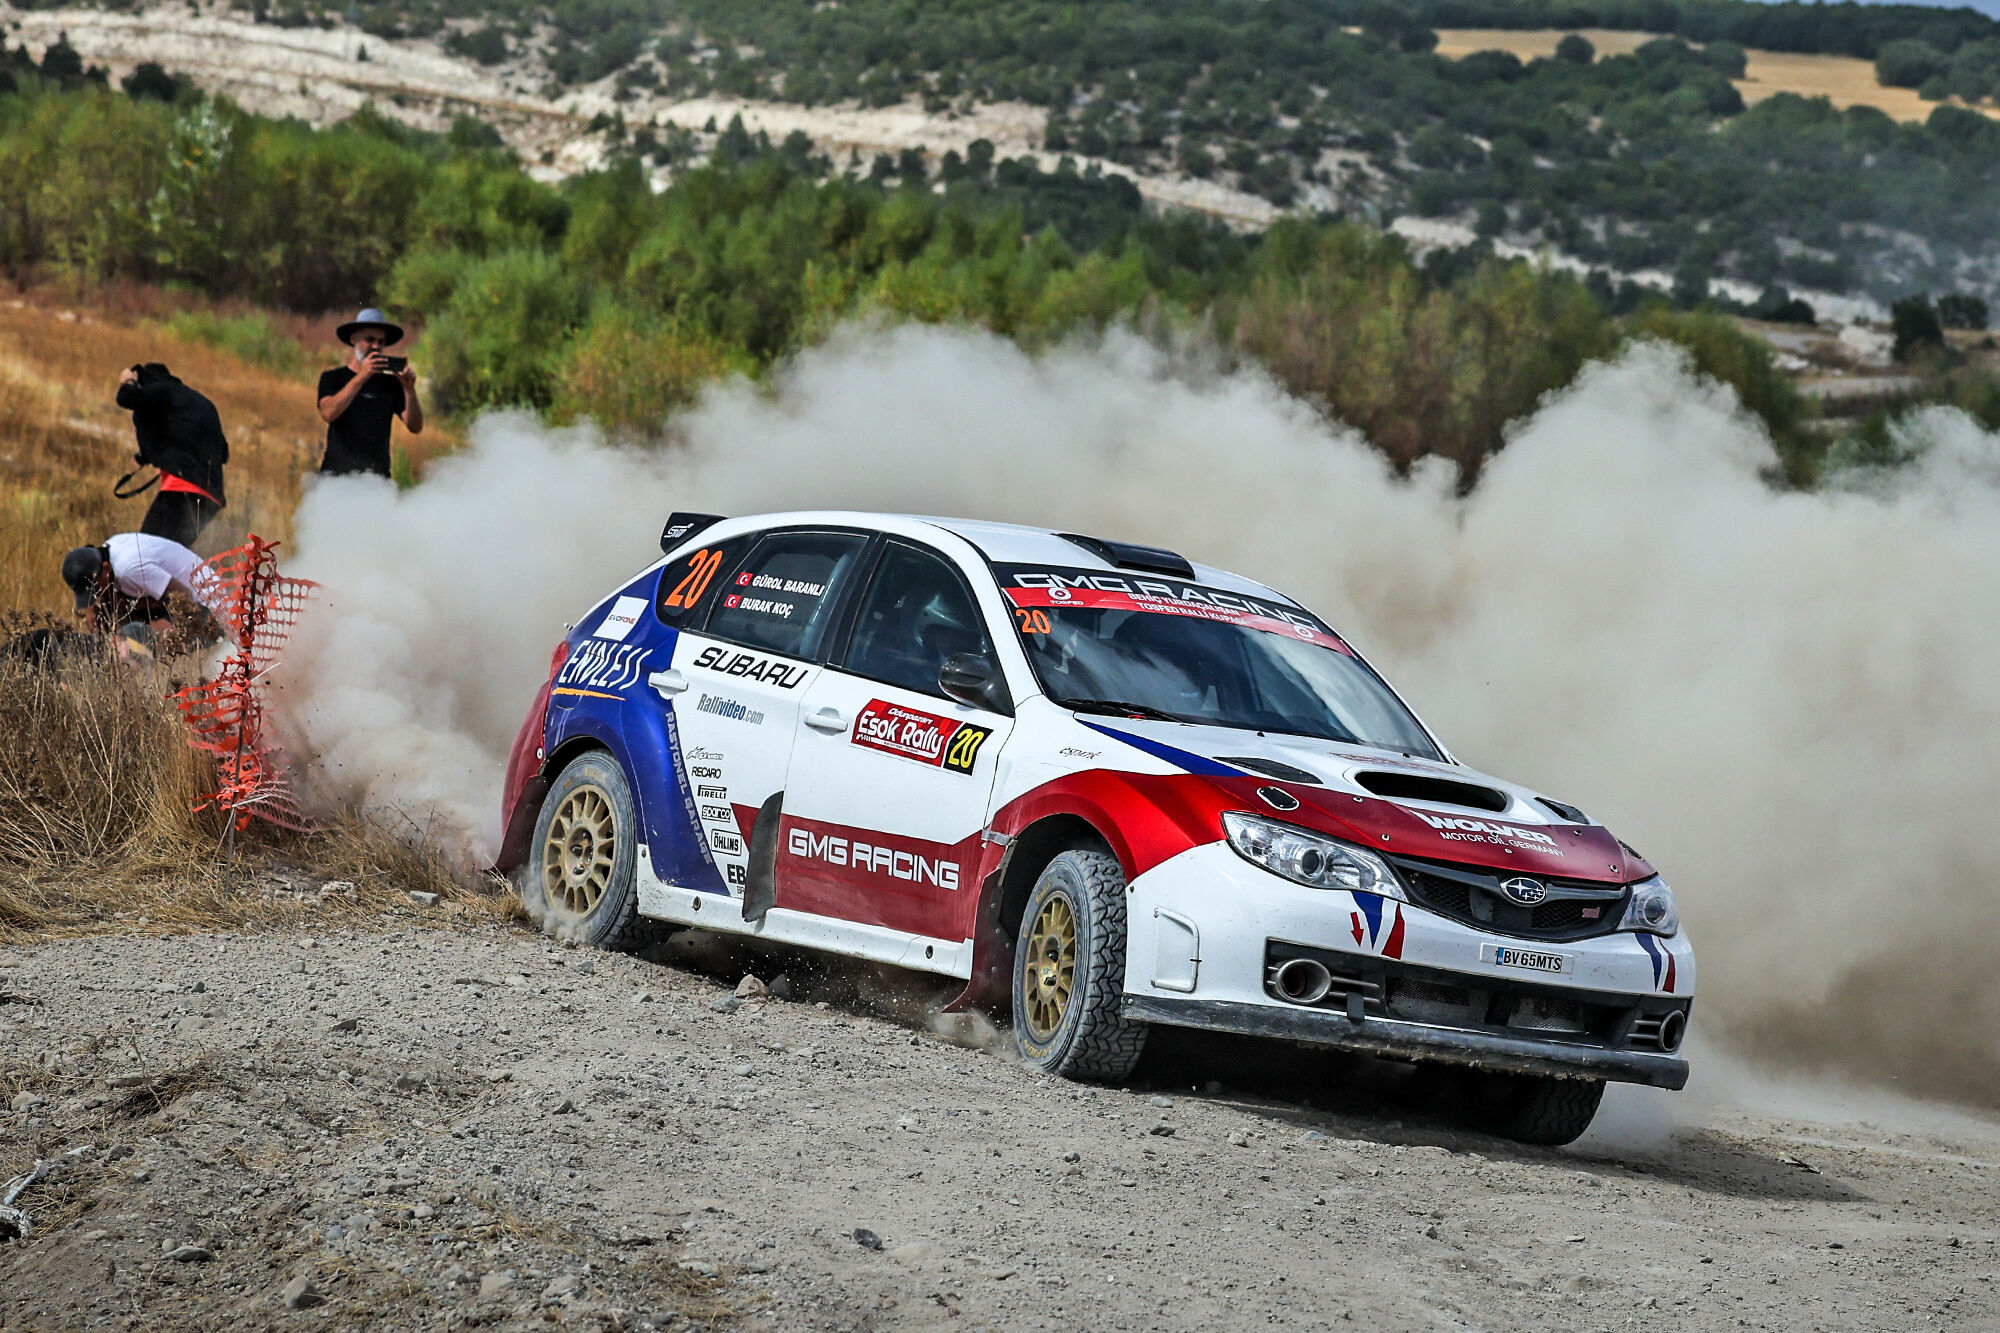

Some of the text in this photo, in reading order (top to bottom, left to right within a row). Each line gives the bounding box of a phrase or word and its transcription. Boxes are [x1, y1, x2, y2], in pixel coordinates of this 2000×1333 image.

[664, 549, 723, 609] 20
[752, 574, 825, 597] GÜROL BARANLI
[740, 598, 794, 619] BURAK KOÇ
[1013, 574, 1322, 633] GMG RACING
[1136, 602, 1180, 613] TOSFED
[1016, 609, 1051, 634] 20
[558, 640, 653, 690] ENDLESS
[693, 646, 808, 690] SUBARU
[697, 693, 764, 725] Rallivideo.com
[858, 710, 944, 758] Esok Rally
[948, 728, 984, 768] 20
[691, 766, 722, 779] RECARO
[666, 711, 714, 865] RASYONEL GARAGE
[697, 785, 727, 800] PIRELLI
[702, 805, 731, 821] sparco
[713, 832, 739, 851] ÖHLINS
[1409, 809, 1558, 846] WOLVER
[1440, 832, 1565, 857] MOTOR OIL GERMANY
[789, 828, 960, 891] GMG RACING
[727, 864, 745, 884] EB
